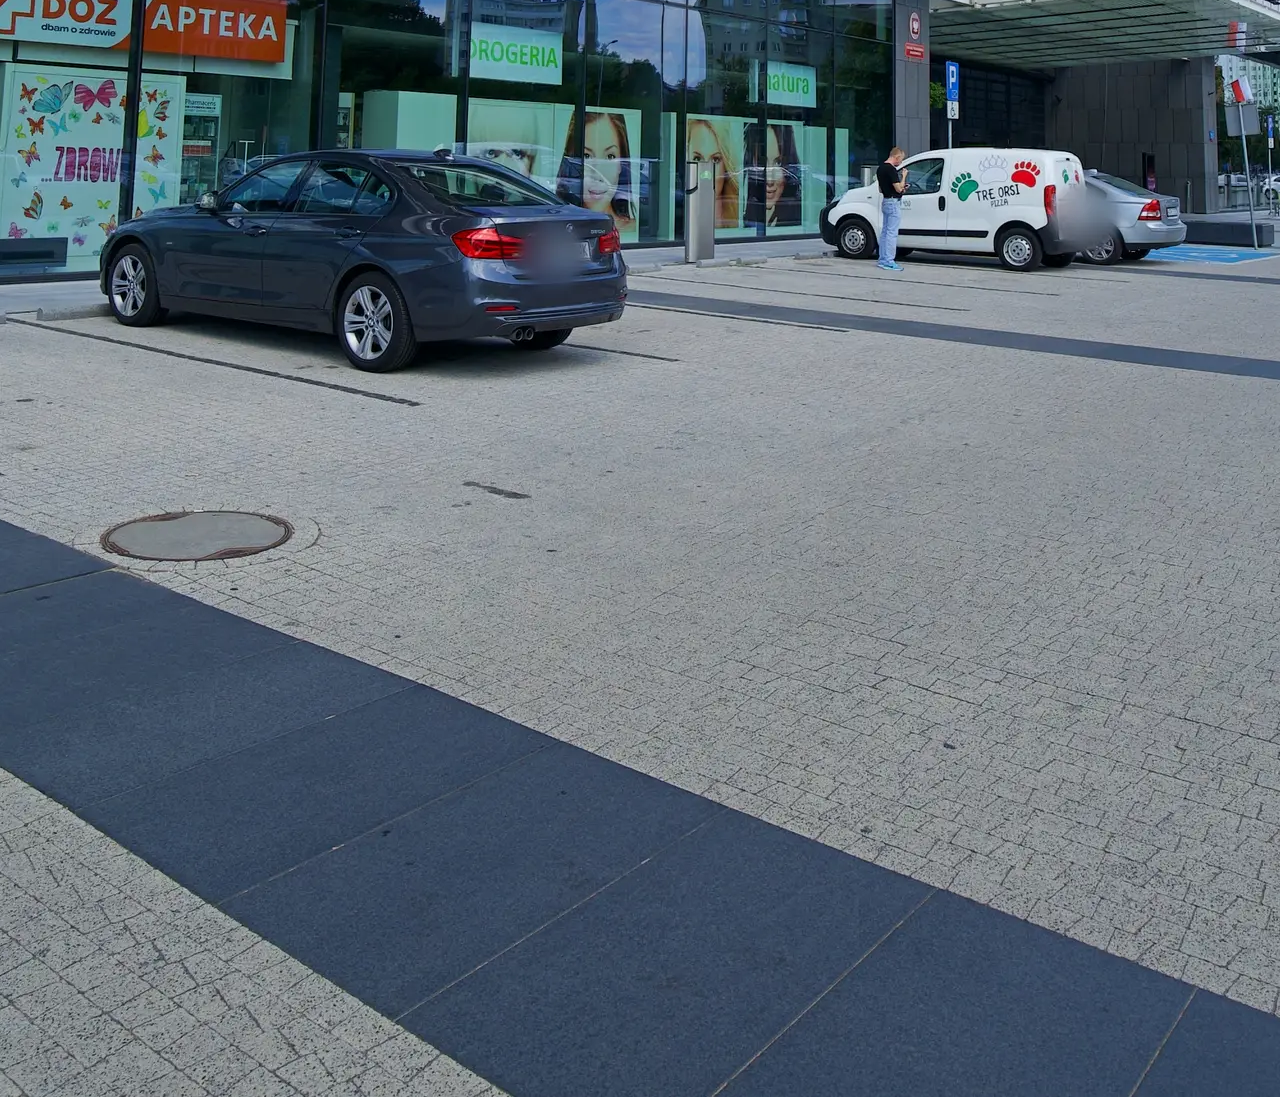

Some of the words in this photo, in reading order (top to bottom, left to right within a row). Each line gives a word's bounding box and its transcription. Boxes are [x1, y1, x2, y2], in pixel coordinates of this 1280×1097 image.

[41, 23, 69, 33] dbam
[79, 27, 116, 37] zdrowie
[150, 3, 278, 41] APTEKA
[950, 65, 957, 89] P
[975, 188, 996, 202] TRE
[998, 184, 1020, 198] ORSI
[990, 198, 1008, 208] PIZZA
